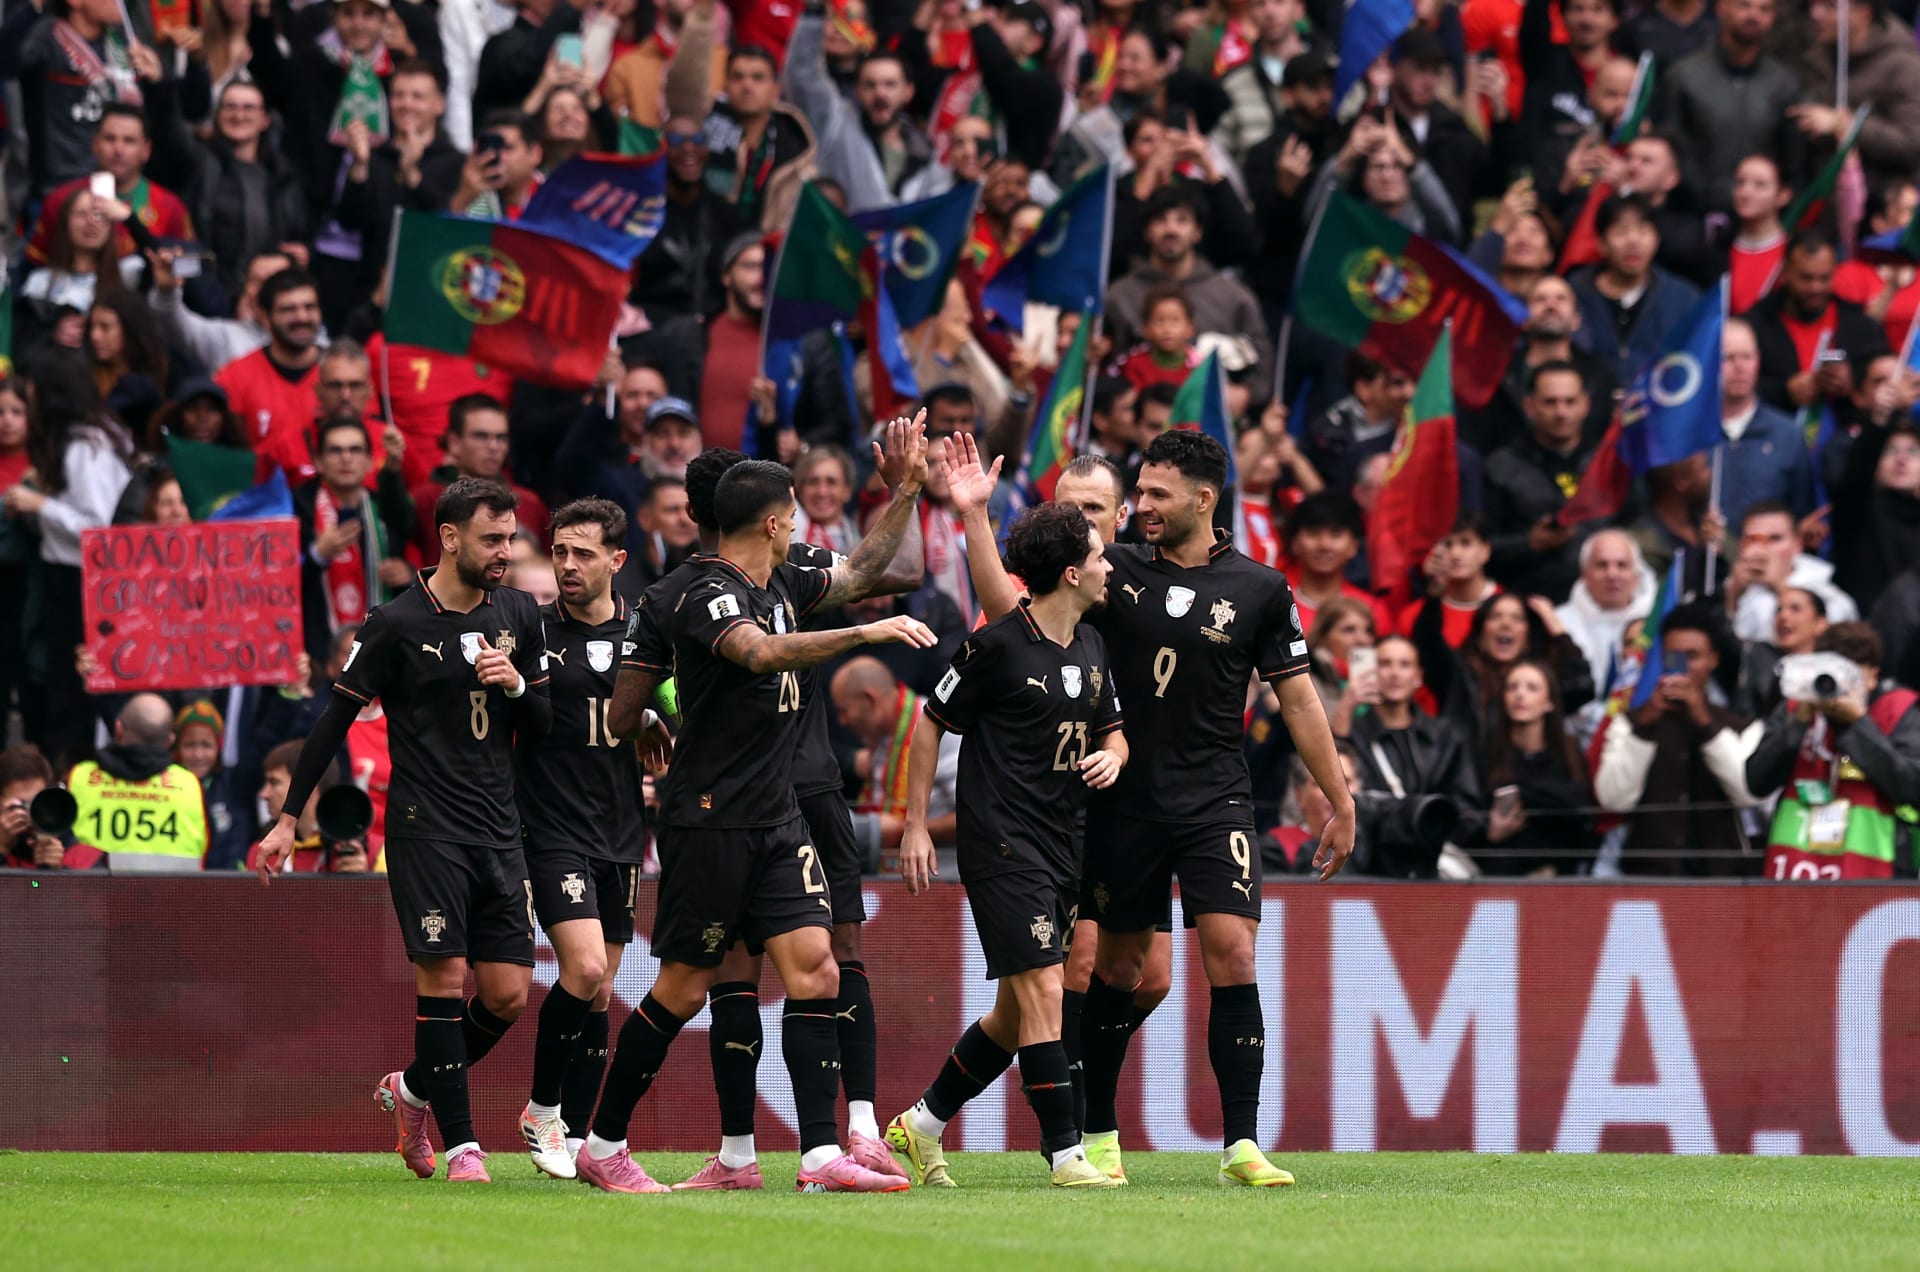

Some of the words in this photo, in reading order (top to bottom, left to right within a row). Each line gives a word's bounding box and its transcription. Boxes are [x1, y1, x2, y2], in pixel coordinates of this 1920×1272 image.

[778, 670, 800, 713] 20
[1153, 646, 1177, 698] 9
[469, 690, 489, 741] 8
[1053, 721, 1089, 772] 23
[88, 808, 179, 843] 1054
[797, 845, 830, 895] 2
[1229, 830, 1251, 880] 9
